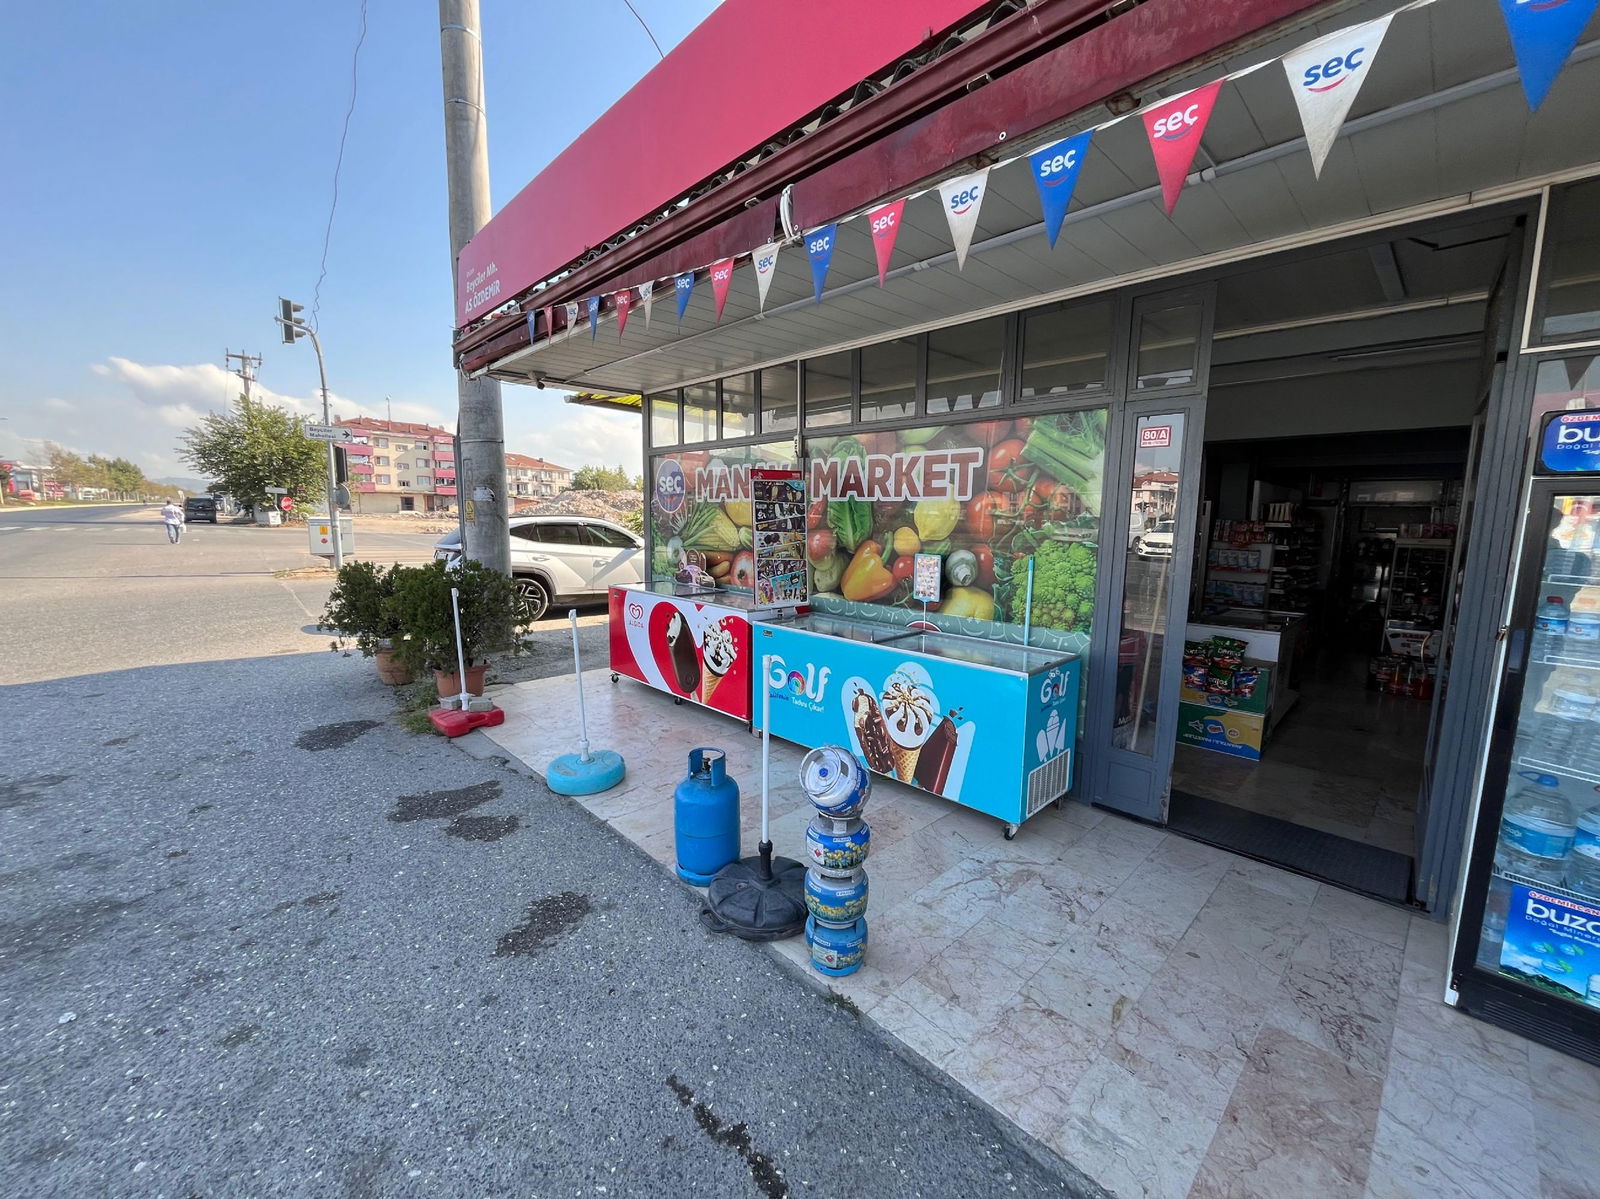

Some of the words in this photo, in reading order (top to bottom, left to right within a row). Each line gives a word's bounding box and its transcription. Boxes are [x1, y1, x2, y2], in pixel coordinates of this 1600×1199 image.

[1302, 47, 1365, 87] seç
[1152, 103, 1199, 139] seç
[1040, 149, 1077, 178] seç
[950, 185, 979, 210] seç
[872, 211, 896, 234] seç
[1144, 429, 1167, 440] 80/A
[659, 475, 682, 493] seç
[696, 461, 791, 502] MAN
[810, 447, 984, 501] MARKET
